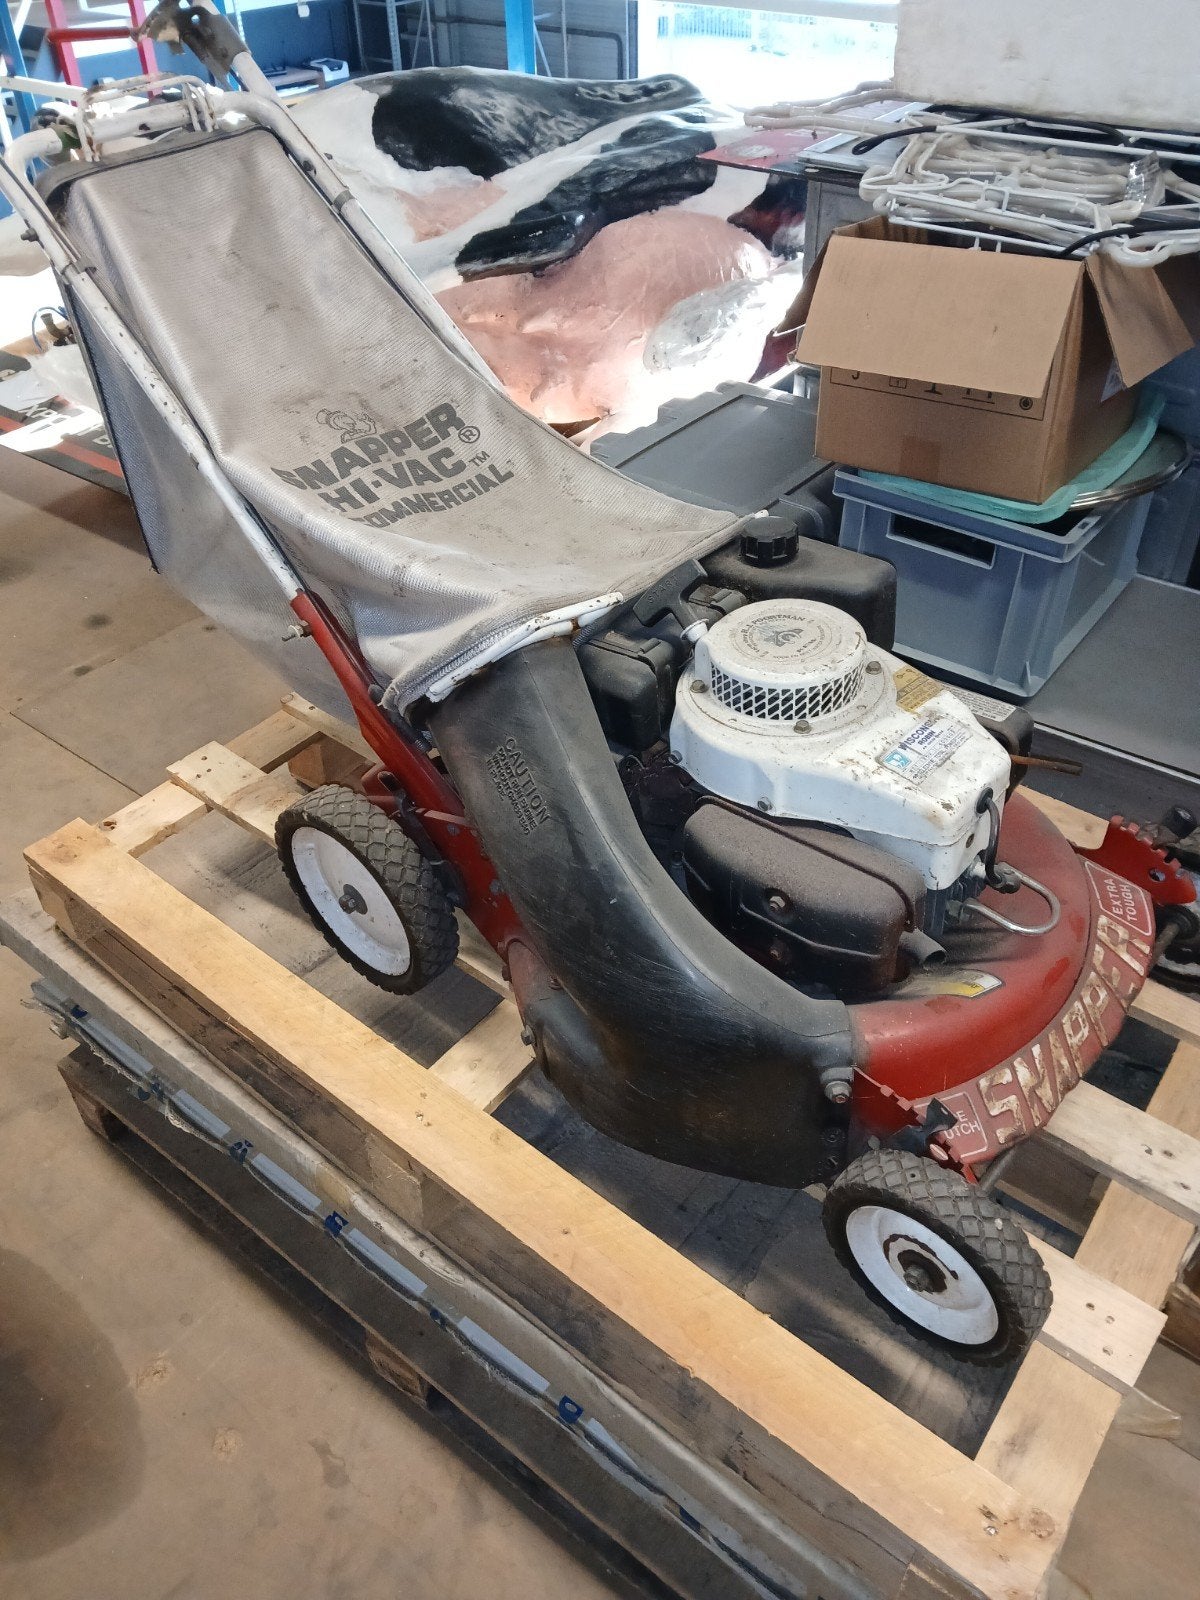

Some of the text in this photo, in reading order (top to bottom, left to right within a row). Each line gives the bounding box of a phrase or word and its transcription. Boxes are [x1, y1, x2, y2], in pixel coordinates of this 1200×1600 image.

[270, 402, 466, 491] SNAPPER
[647, 574, 680, 604] START
[897, 715, 944, 751] WISCONS
[917, 730, 936, 746] ROBIN
[505, 737, 551, 824] CAUTION
[1104, 878, 1123, 915] EXTRA
[1119, 884, 1137, 921] TOUGH
[944, 1120, 980, 1140] UTCH
